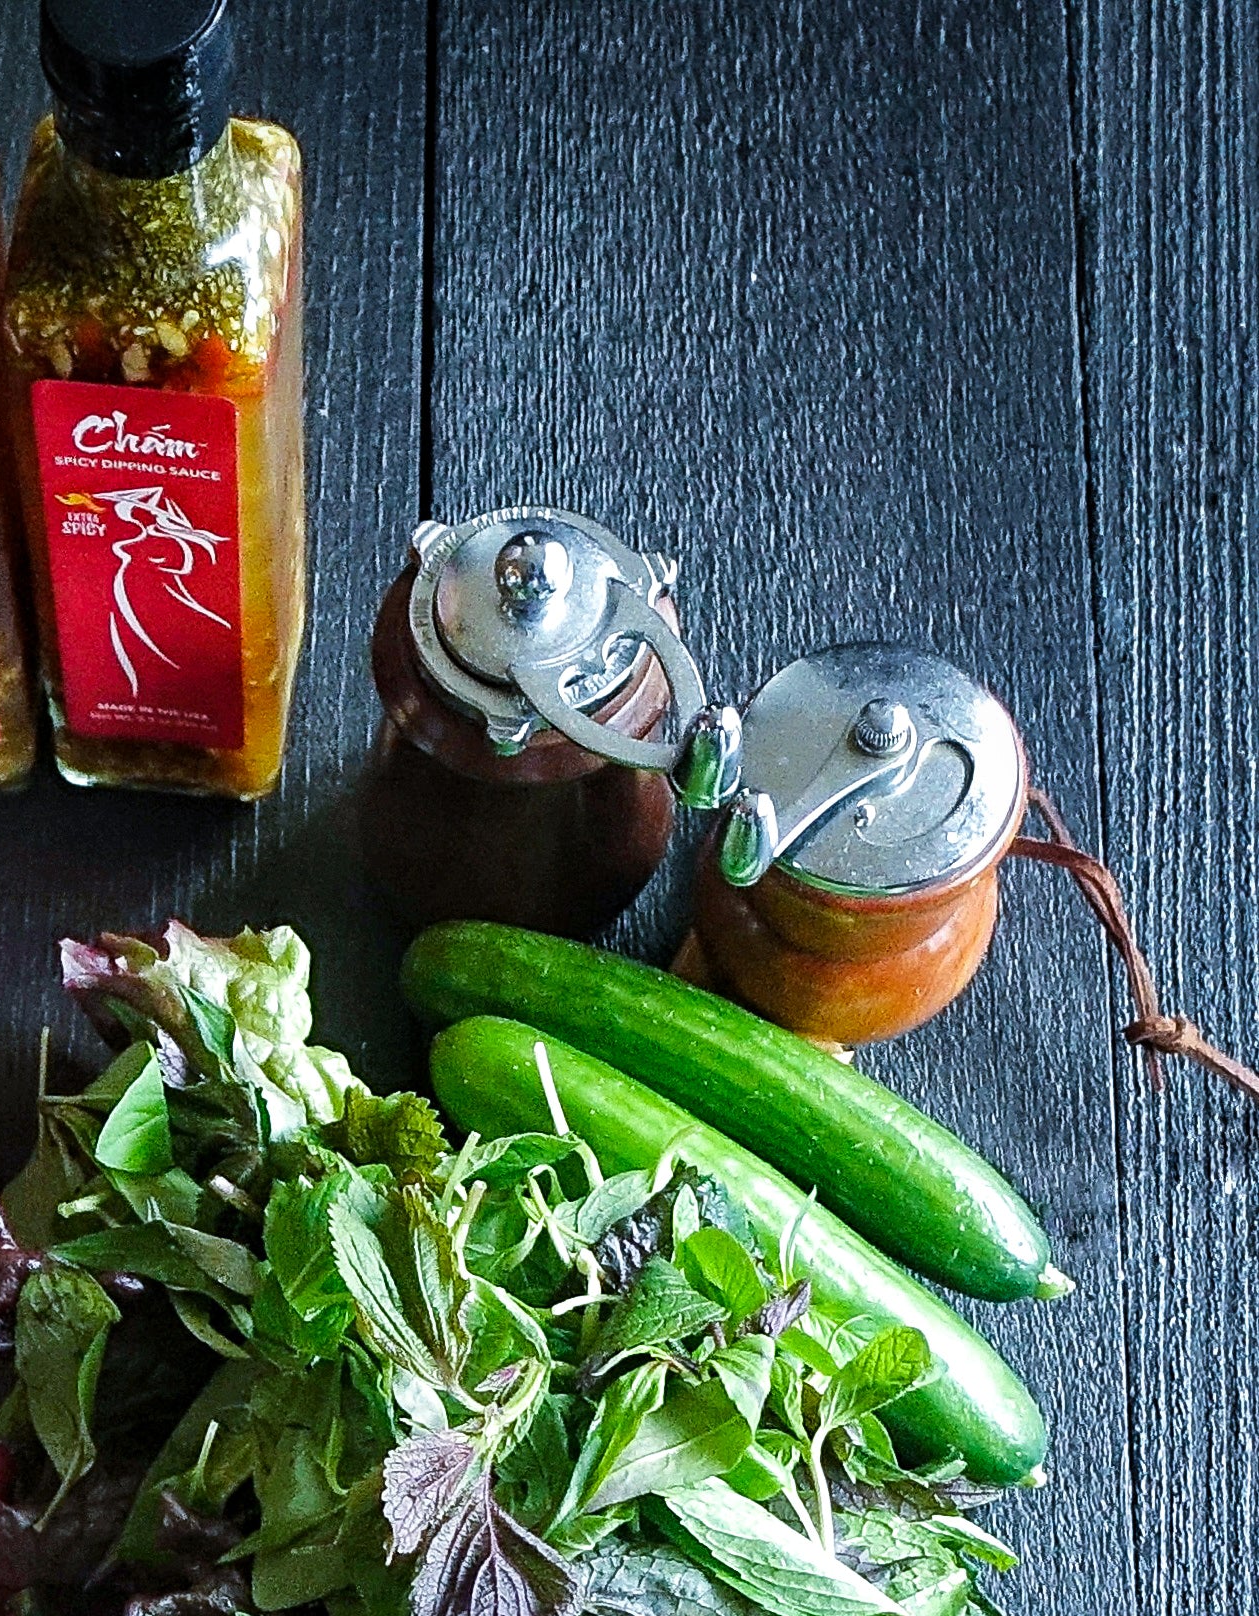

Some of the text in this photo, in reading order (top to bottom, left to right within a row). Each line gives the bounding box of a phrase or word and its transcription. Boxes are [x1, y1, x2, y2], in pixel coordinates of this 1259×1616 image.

[54, 456, 222, 481] SPICY DIPPING SAUCE
[67, 511, 100, 524] EXTRA
[61, 520, 107, 537] SPICY
[96, 702, 135, 711] MADE
[139, 706, 153, 714] IN
[157, 707, 180, 717] THE
